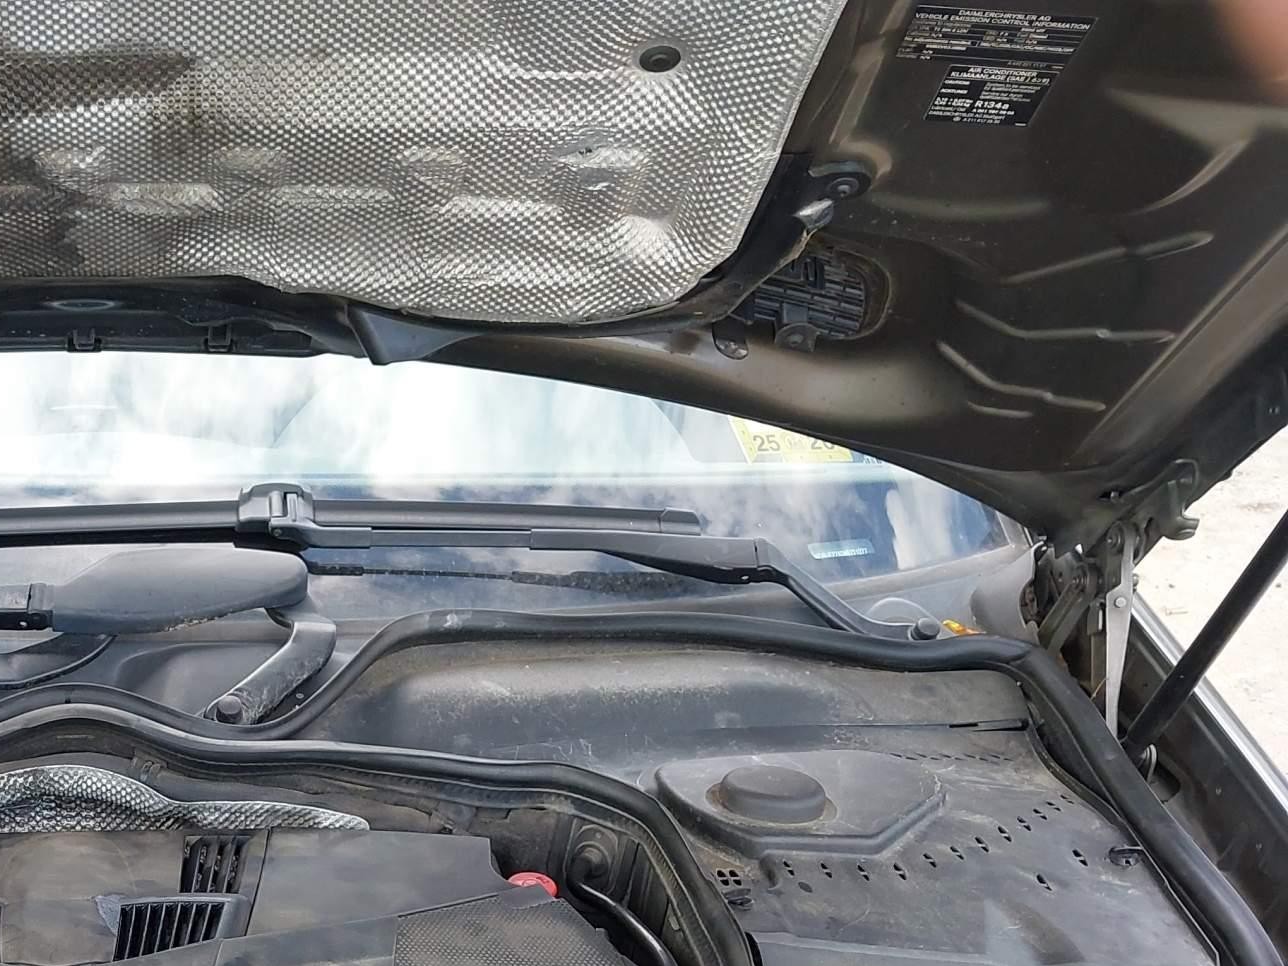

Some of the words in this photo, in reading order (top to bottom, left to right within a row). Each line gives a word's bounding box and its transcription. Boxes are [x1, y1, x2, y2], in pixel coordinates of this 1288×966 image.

[958, 9, 1038, 21] DAIMLERCHRYSLER
[915, 12, 950, 21] VEHICLE
[950, 15, 992, 23] EMISSION
[992, 18, 1030, 26] CONTROL
[1032, 21, 1091, 30] INFORMATION
[951, 71, 1007, 81] KLIMAANLAGE
[983, 68, 1038, 77] CONDITIONER
[974, 100, 1010, 110] R134a
[752, 434, 781, 452] 25
